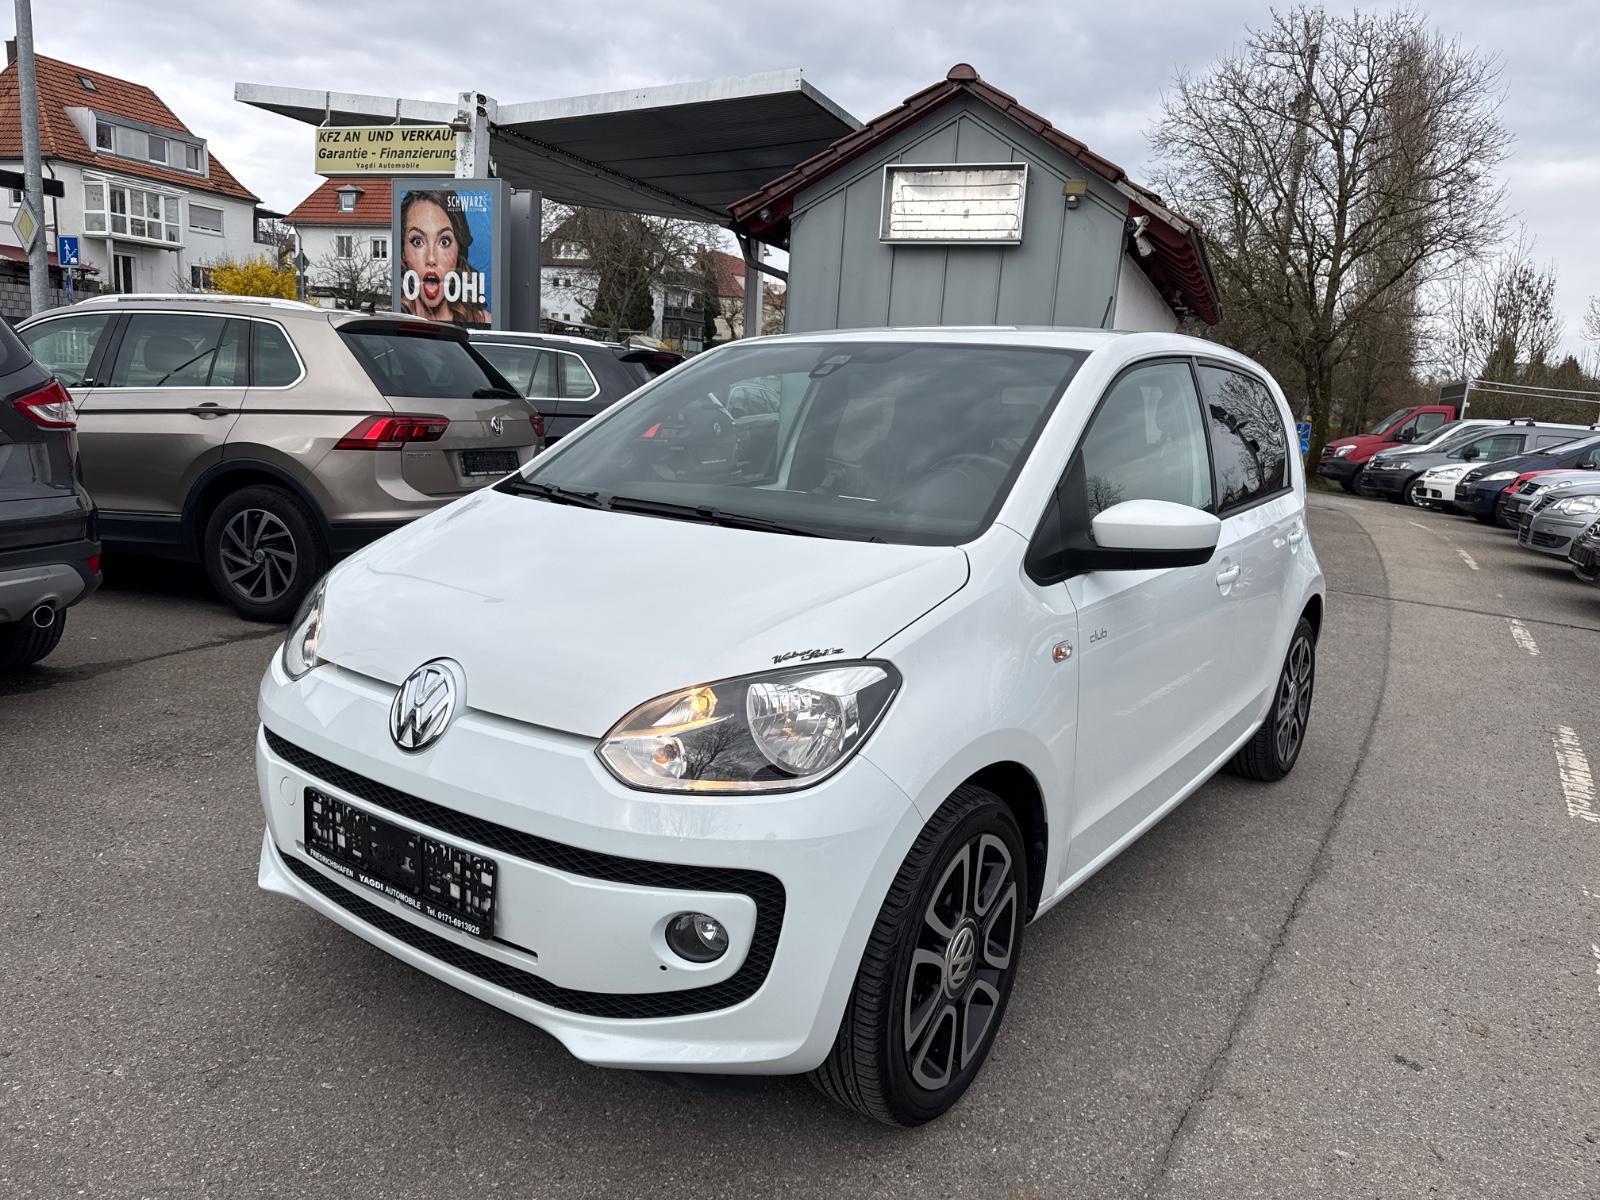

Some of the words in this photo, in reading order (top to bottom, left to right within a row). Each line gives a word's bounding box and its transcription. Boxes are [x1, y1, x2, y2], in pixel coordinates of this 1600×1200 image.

[318, 131, 340, 143] KFZ
[343, 131, 361, 143] AN
[367, 130, 394, 142] UND
[318, 147, 368, 159] Garantie
[379, 147, 457, 161] Finanzierung
[355, 162, 376, 170] Yagdi
[1089, 627, 1108, 643] club
[358, 873, 384, 891] YAGDI
[384, 885, 421, 910] AUTOMOBILE
[426, 905, 437, 918] Tel.
